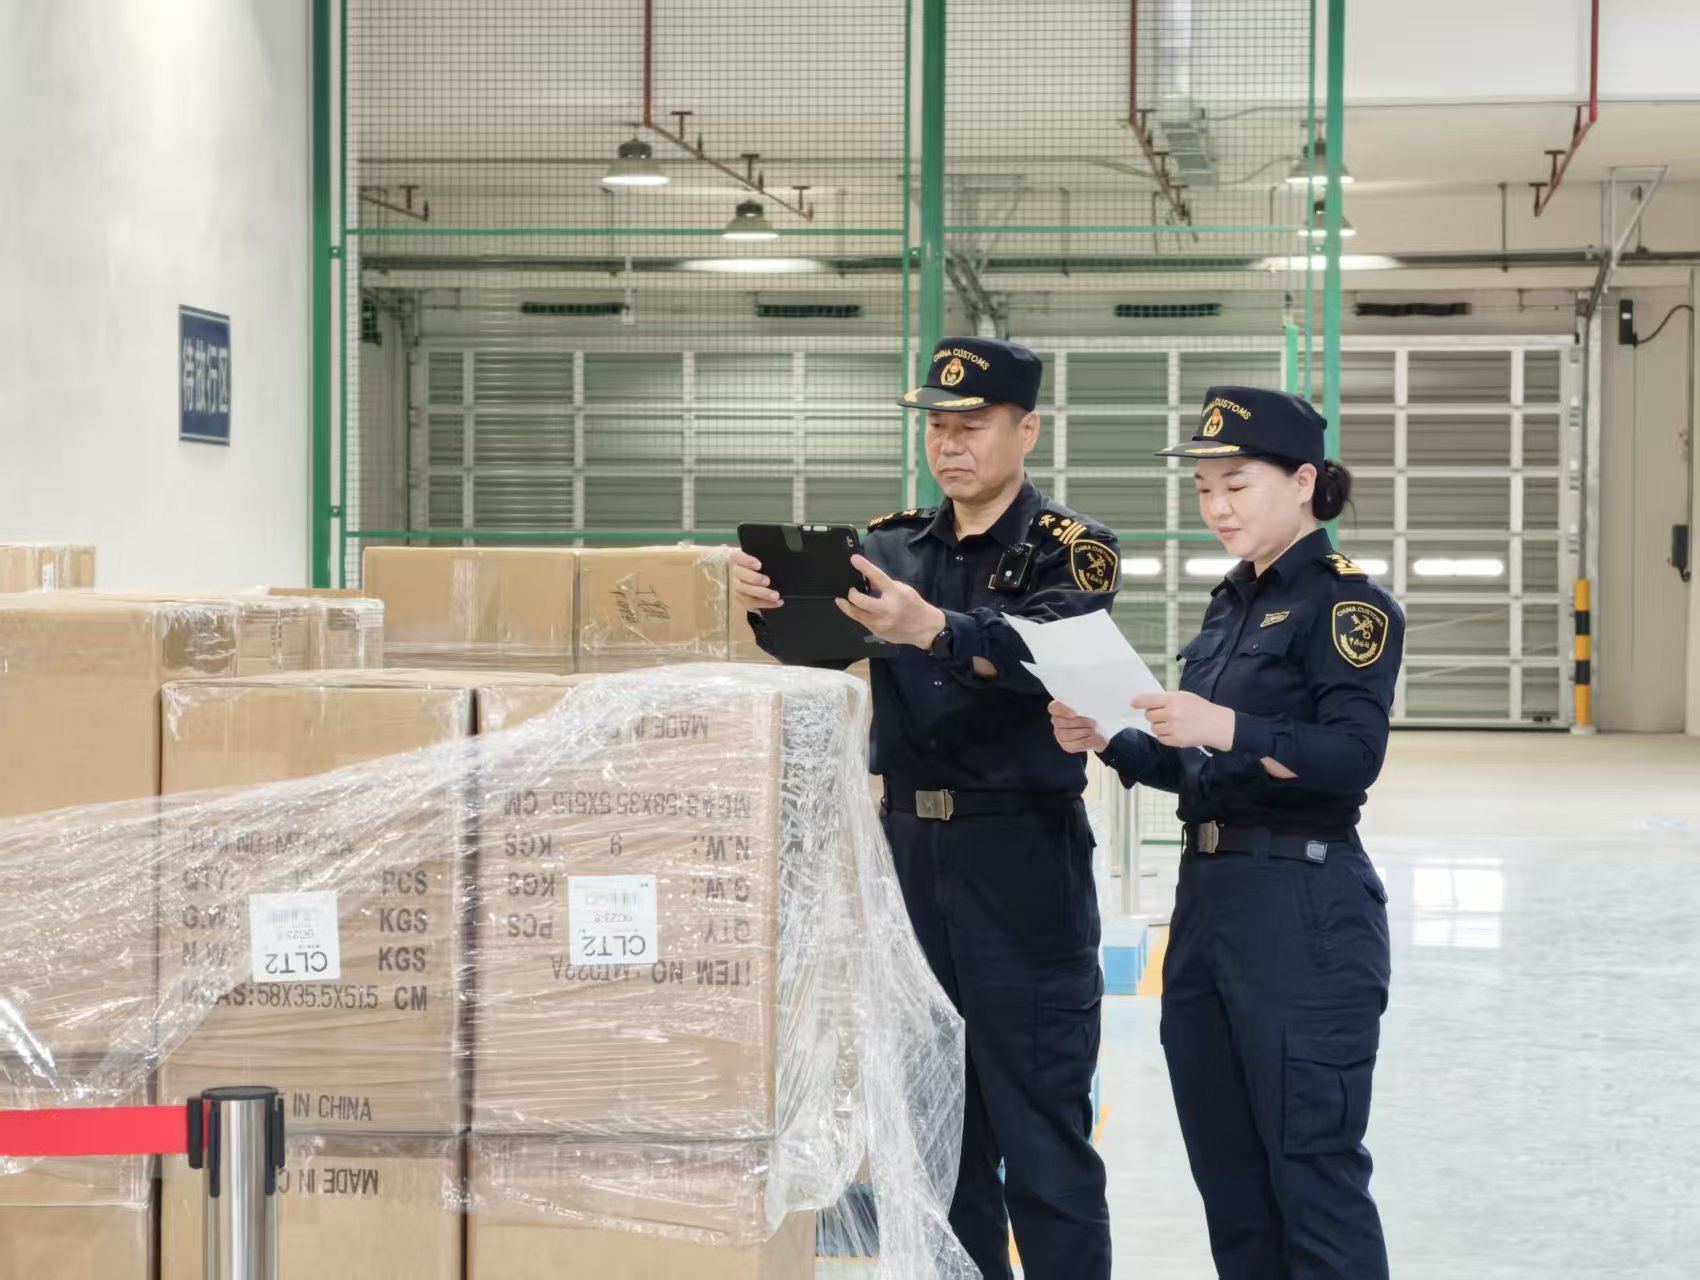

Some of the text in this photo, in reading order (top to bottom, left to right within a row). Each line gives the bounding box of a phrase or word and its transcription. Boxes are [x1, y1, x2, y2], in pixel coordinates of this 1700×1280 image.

[953, 348, 990, 371] CUSTOMS
[1214, 397, 1252, 420] CUSTOMS
[1336, 606, 1385, 628] CHINA CUSTOMS
[504, 790, 537, 816] CM
[504, 832, 552, 858] KGS
[382, 870, 428, 896] PCS
[379, 907, 428, 934] KGS
[507, 912, 553, 939] PCS
[581, 934, 646, 957] CLT2
[263, 950, 329, 975] CLT2
[377, 946, 427, 973] KGS
[697, 958, 751, 986] ITEM
[393, 984, 428, 1012] CM
[292, 1092, 372, 1121] IN CHINA
[299, 1167, 316, 1194] IN
[323, 1167, 379, 1195] MADE
